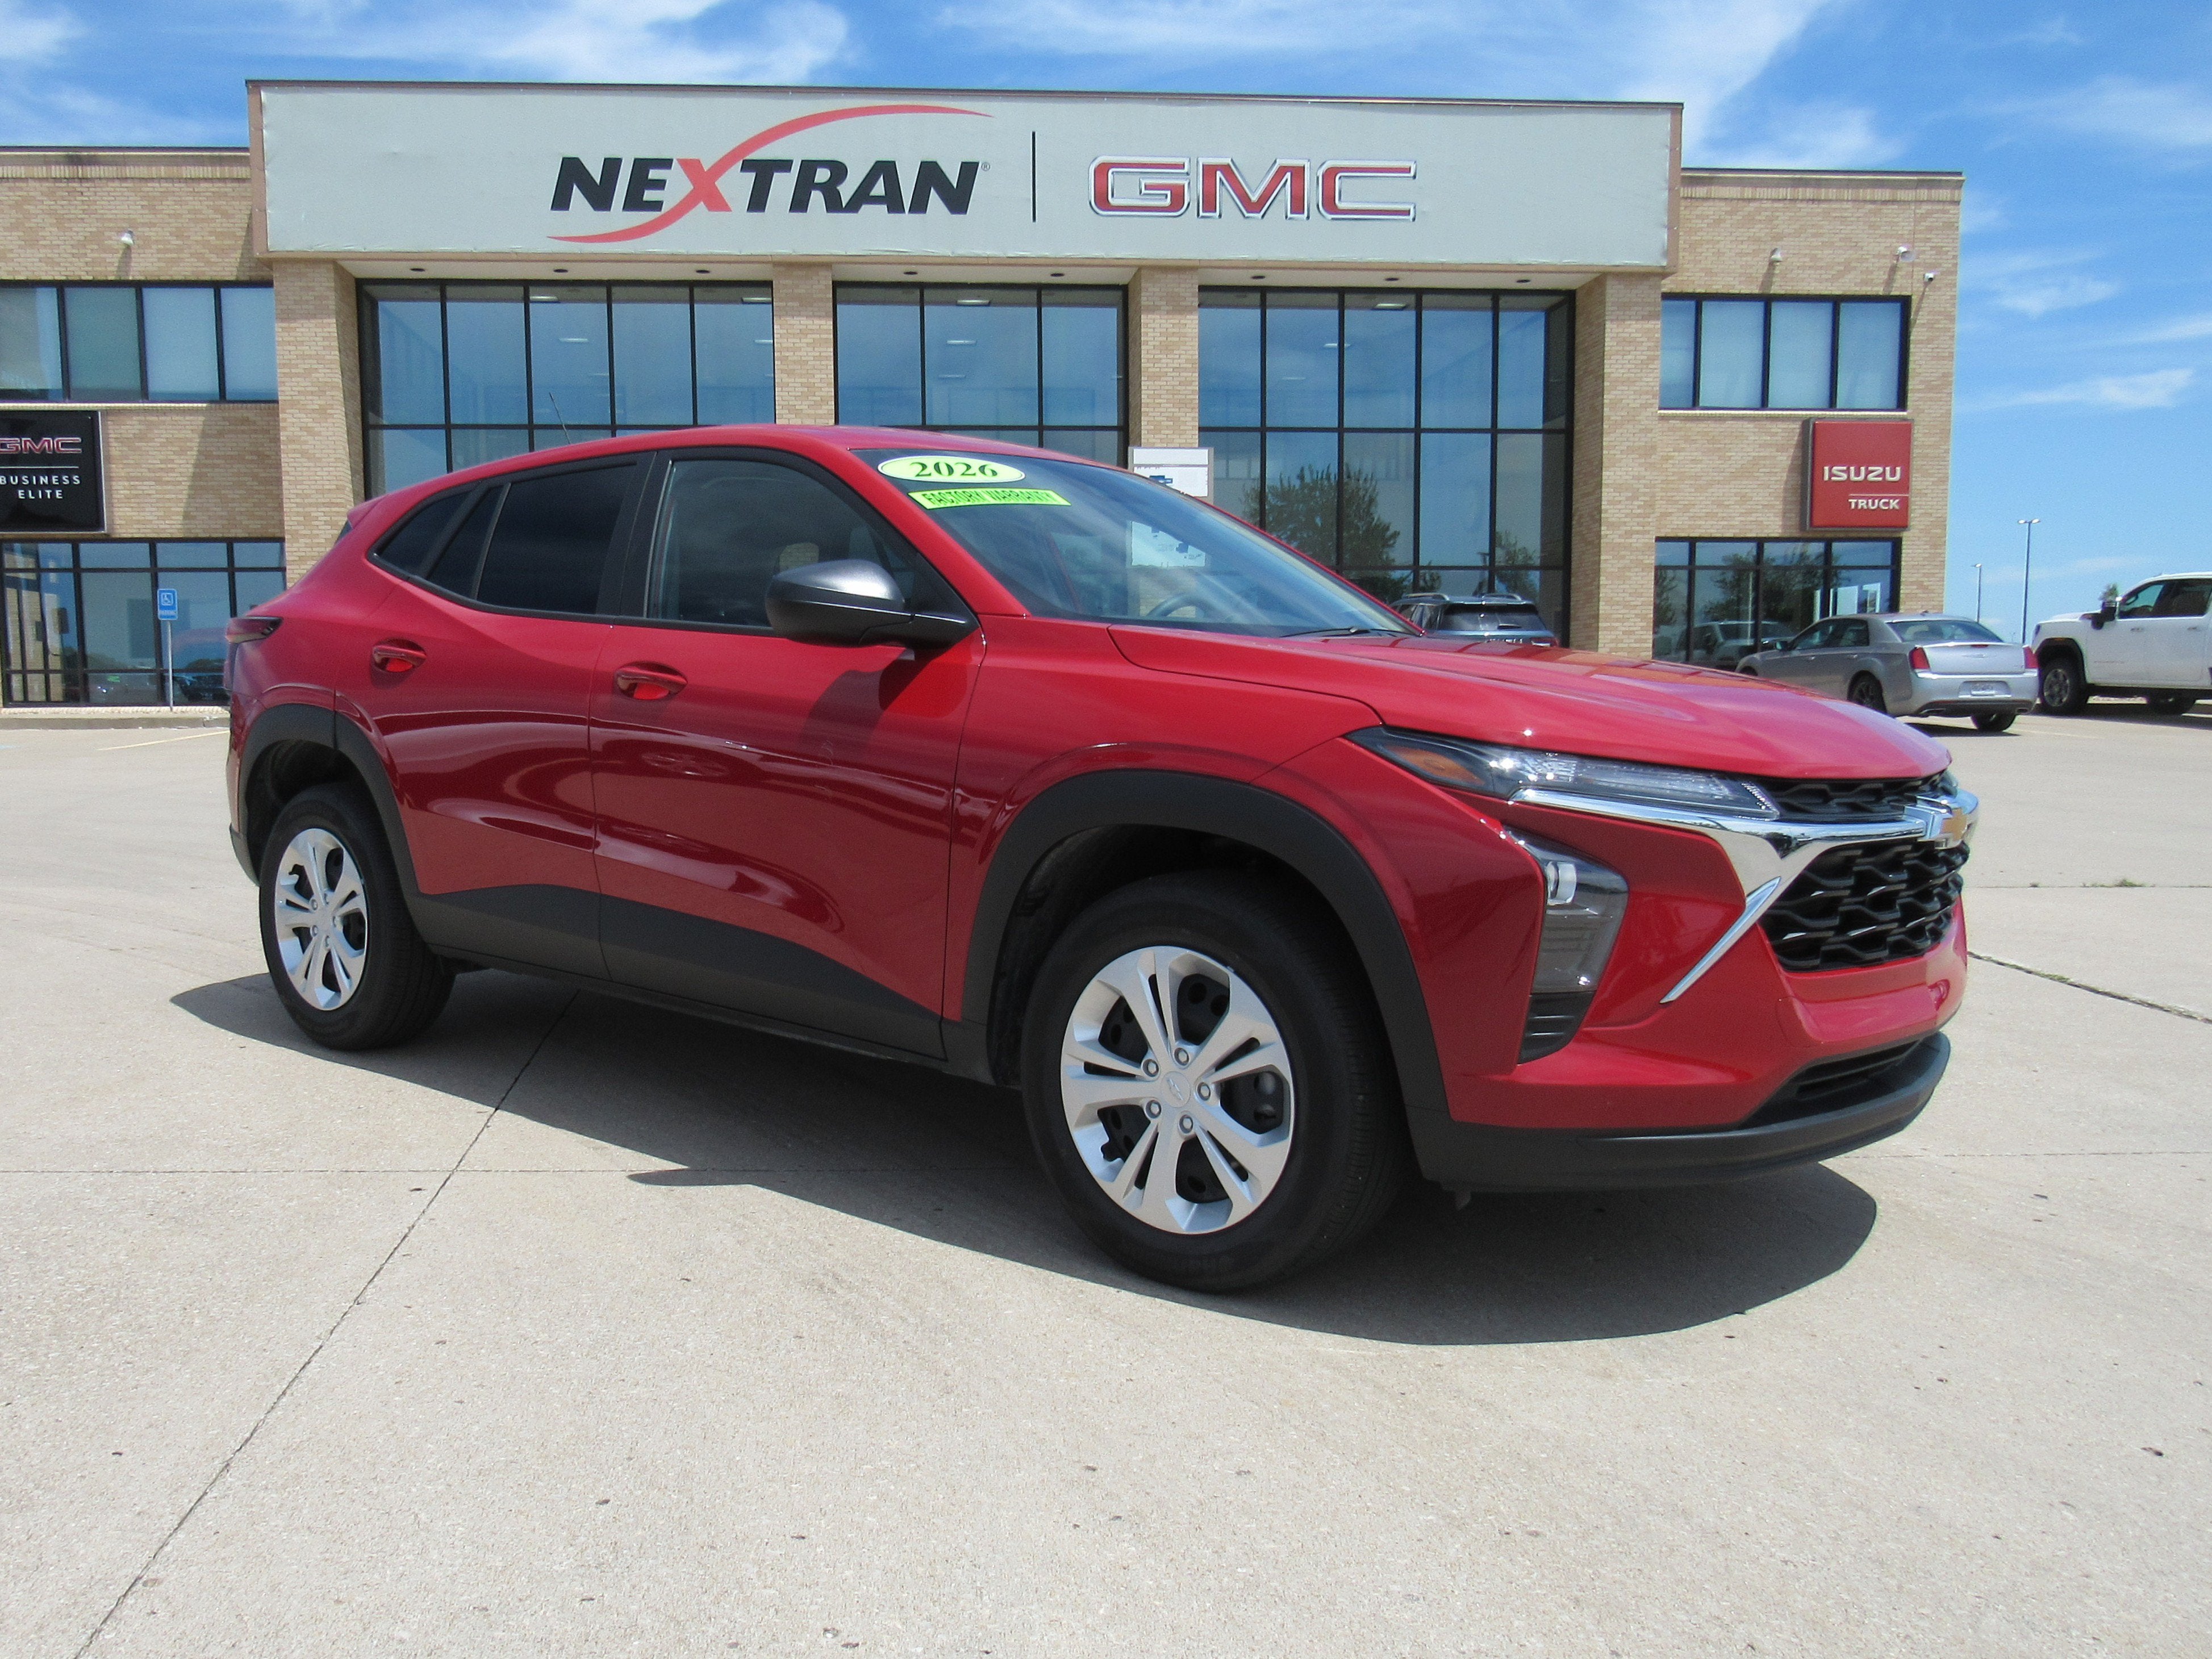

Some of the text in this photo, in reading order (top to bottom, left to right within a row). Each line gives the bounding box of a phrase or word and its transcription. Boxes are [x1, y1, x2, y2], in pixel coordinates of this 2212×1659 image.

[550, 156, 979, 215] NEXTRAN
[1089, 156, 1417, 220] GMC
[0, 437, 82, 454] GMC
[909, 461, 998, 477] 2026
[1823, 466, 1901, 481] ISUZU
[0, 475, 81, 485] BUSINESS
[18, 490, 62, 499] ELITE
[921, 489, 1057, 505] FACTORY WARRANTY
[1848, 499, 1899, 510] TRUCK
